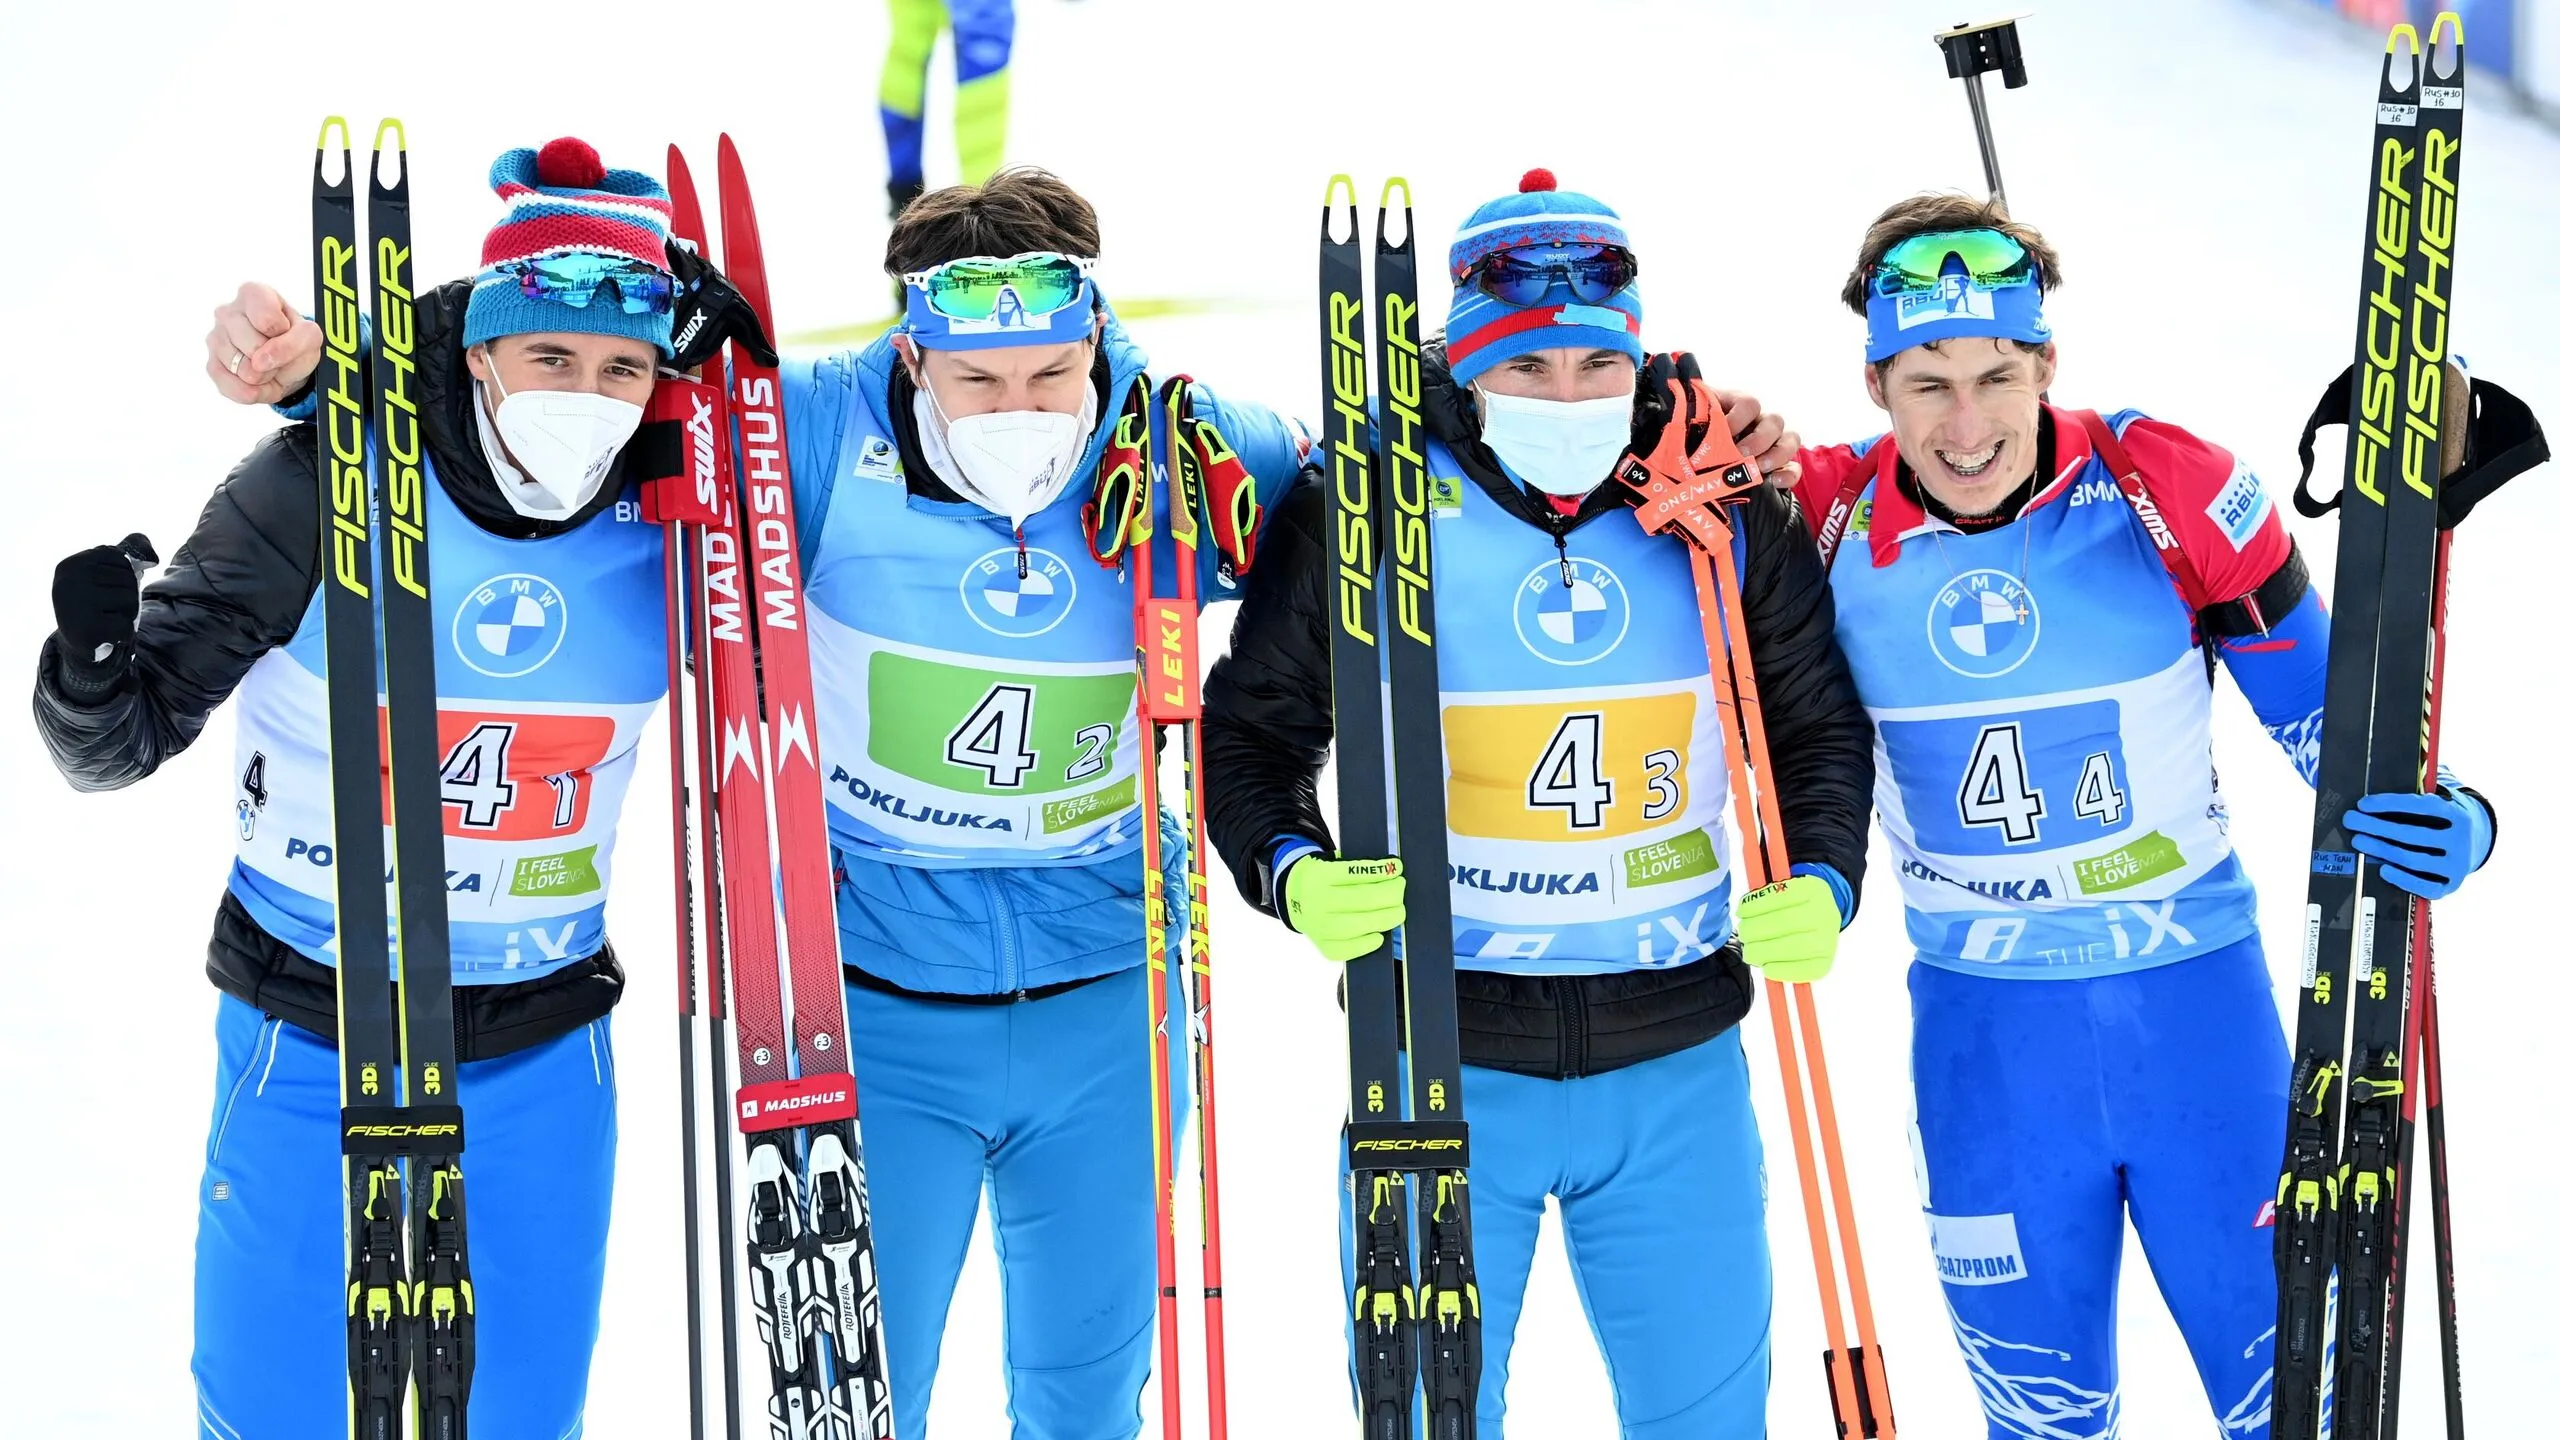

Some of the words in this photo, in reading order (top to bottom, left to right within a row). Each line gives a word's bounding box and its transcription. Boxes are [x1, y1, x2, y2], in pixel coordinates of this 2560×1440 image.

[674, 308, 708, 354] SWIX
[2355, 138, 2415, 507] FISCHER
[2400, 129, 2458, 499] FISCHER
[322, 236, 369, 598] FISCHER
[378, 236, 427, 599] FISCHER
[687, 391, 718, 515] SWIX
[1329, 292, 1375, 646] FISCHER
[1385, 292, 1432, 646] FISCHER
[741, 377, 798, 630] MADSHUS
[1184, 462, 1198, 509] LEKI
[1955, 518, 1993, 526] CRAFT
[475, 579, 556, 608] BMW
[1942, 574, 2022, 609] BMW
[1160, 608, 1185, 708] LEKI
[944, 682, 1039, 789] 4
[1065, 722, 1114, 783] 2
[242, 750, 268, 814] 4
[440, 721, 518, 829] 4
[543, 771, 582, 828] 1
[1526, 710, 1615, 832] 4
[1642, 749, 1683, 822] 3
[1955, 721, 2047, 847] 4
[2073, 751, 2126, 827] 4
[829, 764, 1013, 833] POKLJUKA
[1058, 794, 1097, 811] FEEL
[518, 861, 528, 876] I
[530, 855, 567, 874] FEEL
[1628, 851, 1637, 866] I
[1639, 841, 1676, 863] FEEL
[1631, 846, 1706, 883] SLOVENIA
[2079, 862, 2089, 877] I
[2092, 850, 2135, 871] FEEL
[1448, 863, 1599, 896] KLJUKA
[1149, 869, 1167, 974] LEKI
[1189, 872, 1211, 976] LEKI
[2313, 976, 2331, 1005] 3D
[2369, 971, 2387, 1001] 3D
[361, 1067, 379, 1096] 3D
[424, 1067, 441, 1096] 3D
[764, 1091, 846, 1113] MADSHUS
[1367, 1085, 1384, 1113] 3D
[1428, 1083, 1446, 1112] 3D
[346, 1124, 458, 1137] FISCHER
[1353, 1139, 1462, 1152] FISCHER
